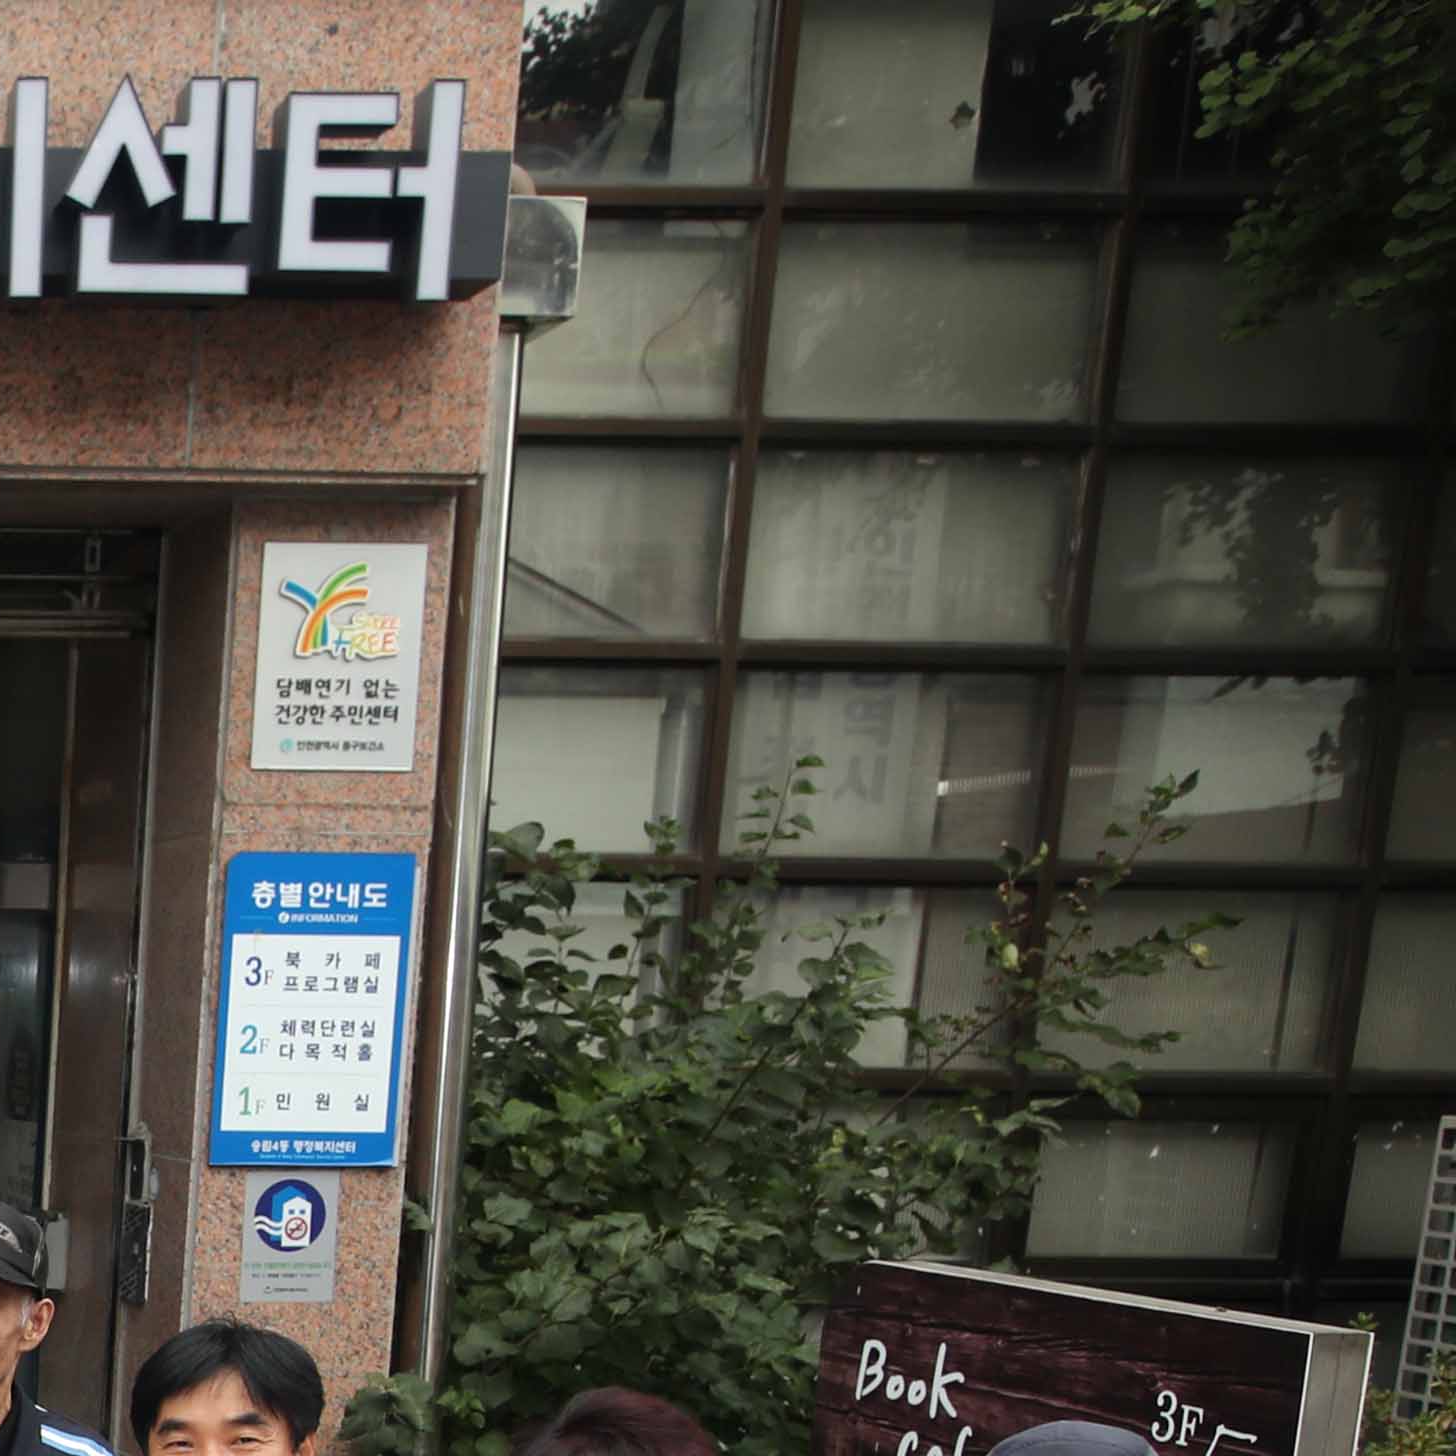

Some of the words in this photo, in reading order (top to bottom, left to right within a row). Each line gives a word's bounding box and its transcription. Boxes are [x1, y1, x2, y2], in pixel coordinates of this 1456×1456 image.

[275, 677, 352, 699] 담배연기
[363, 678, 400, 700] 없는
[275, 704, 326, 726] 건강한
[330, 704, 399, 726] 주민센터
[251, 880, 304, 909] 층별
[308, 881, 388, 909] 안내도
[854, 1338, 966, 1420] Book
[1151, 1390, 1205, 1447] 3F
